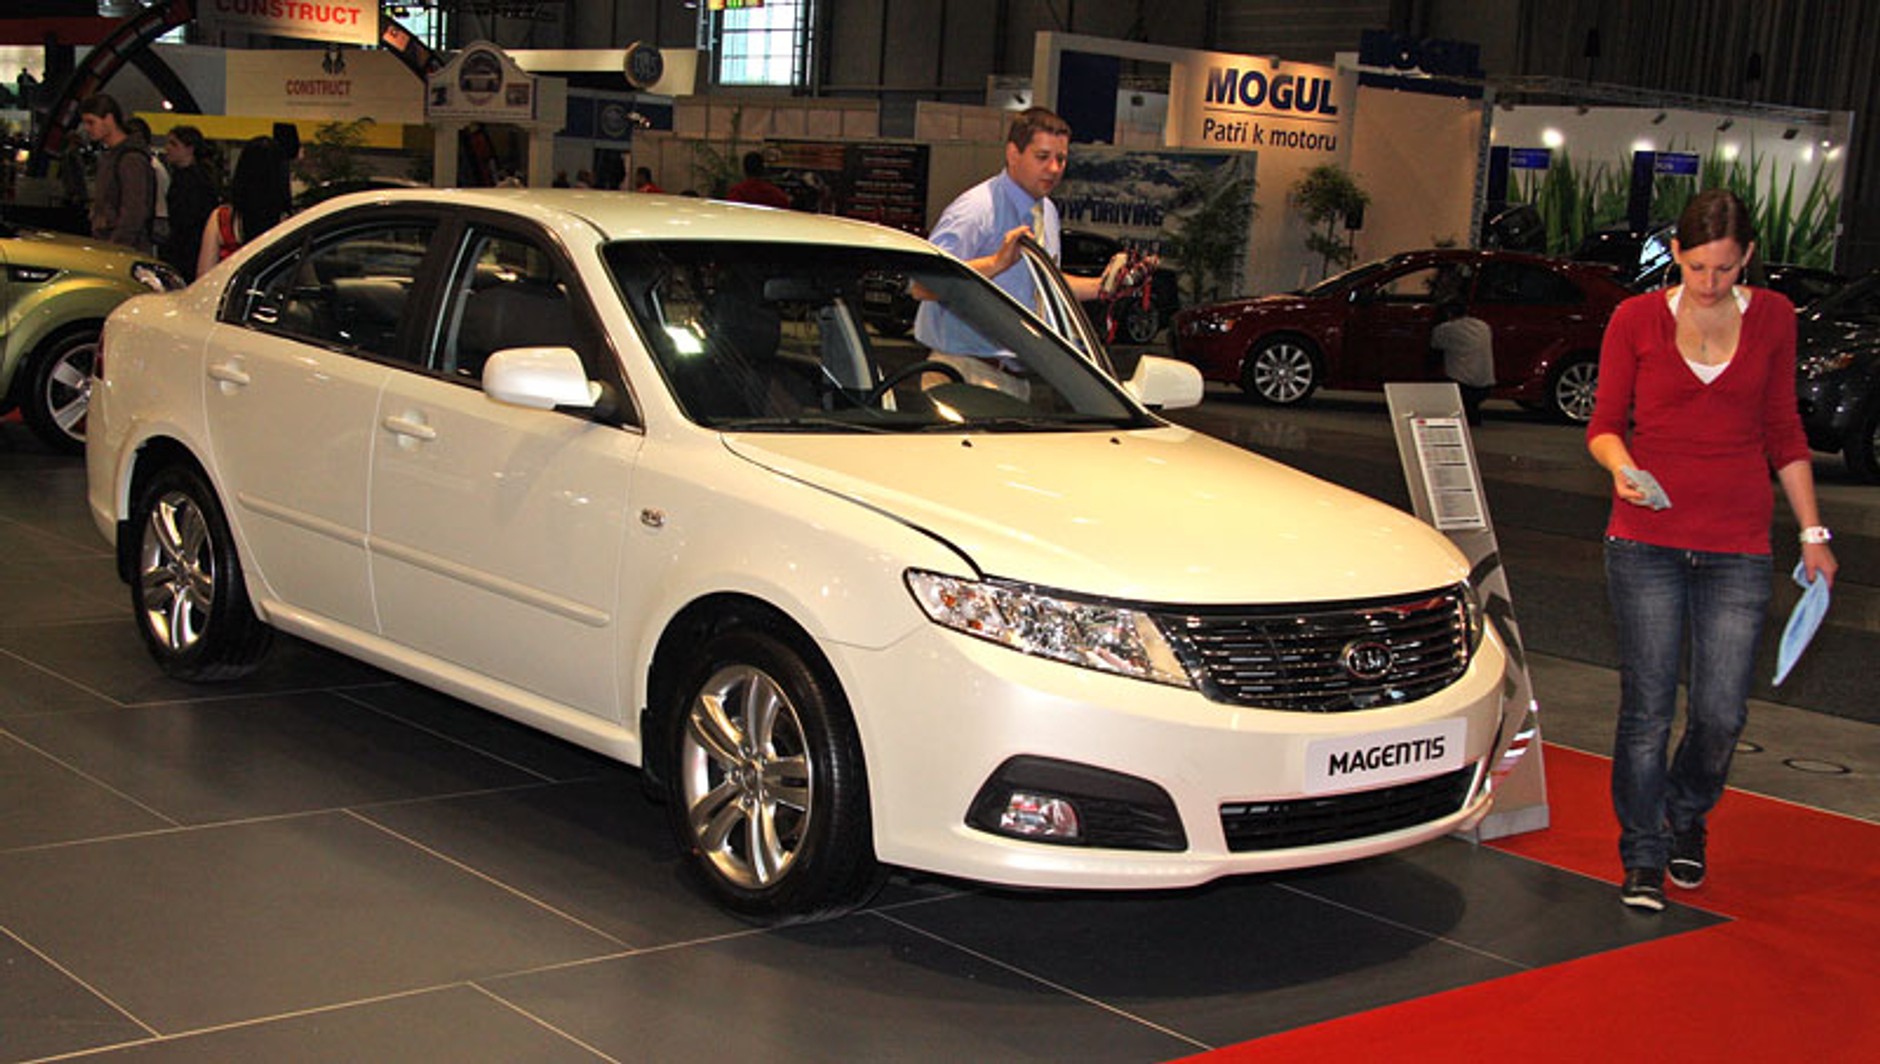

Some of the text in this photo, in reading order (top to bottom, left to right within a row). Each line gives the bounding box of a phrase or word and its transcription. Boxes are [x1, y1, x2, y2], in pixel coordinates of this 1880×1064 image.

[215, 0, 361, 25] CONSTRUCT
[285, 79, 352, 96] CONSTRUCT
[1205, 68, 1338, 115] MOGUL
[1203, 117, 1336, 151] Patří k motoru
[1090, 199, 1164, 227] DRIVING
[1328, 736, 1445, 776] MAGENTIS
